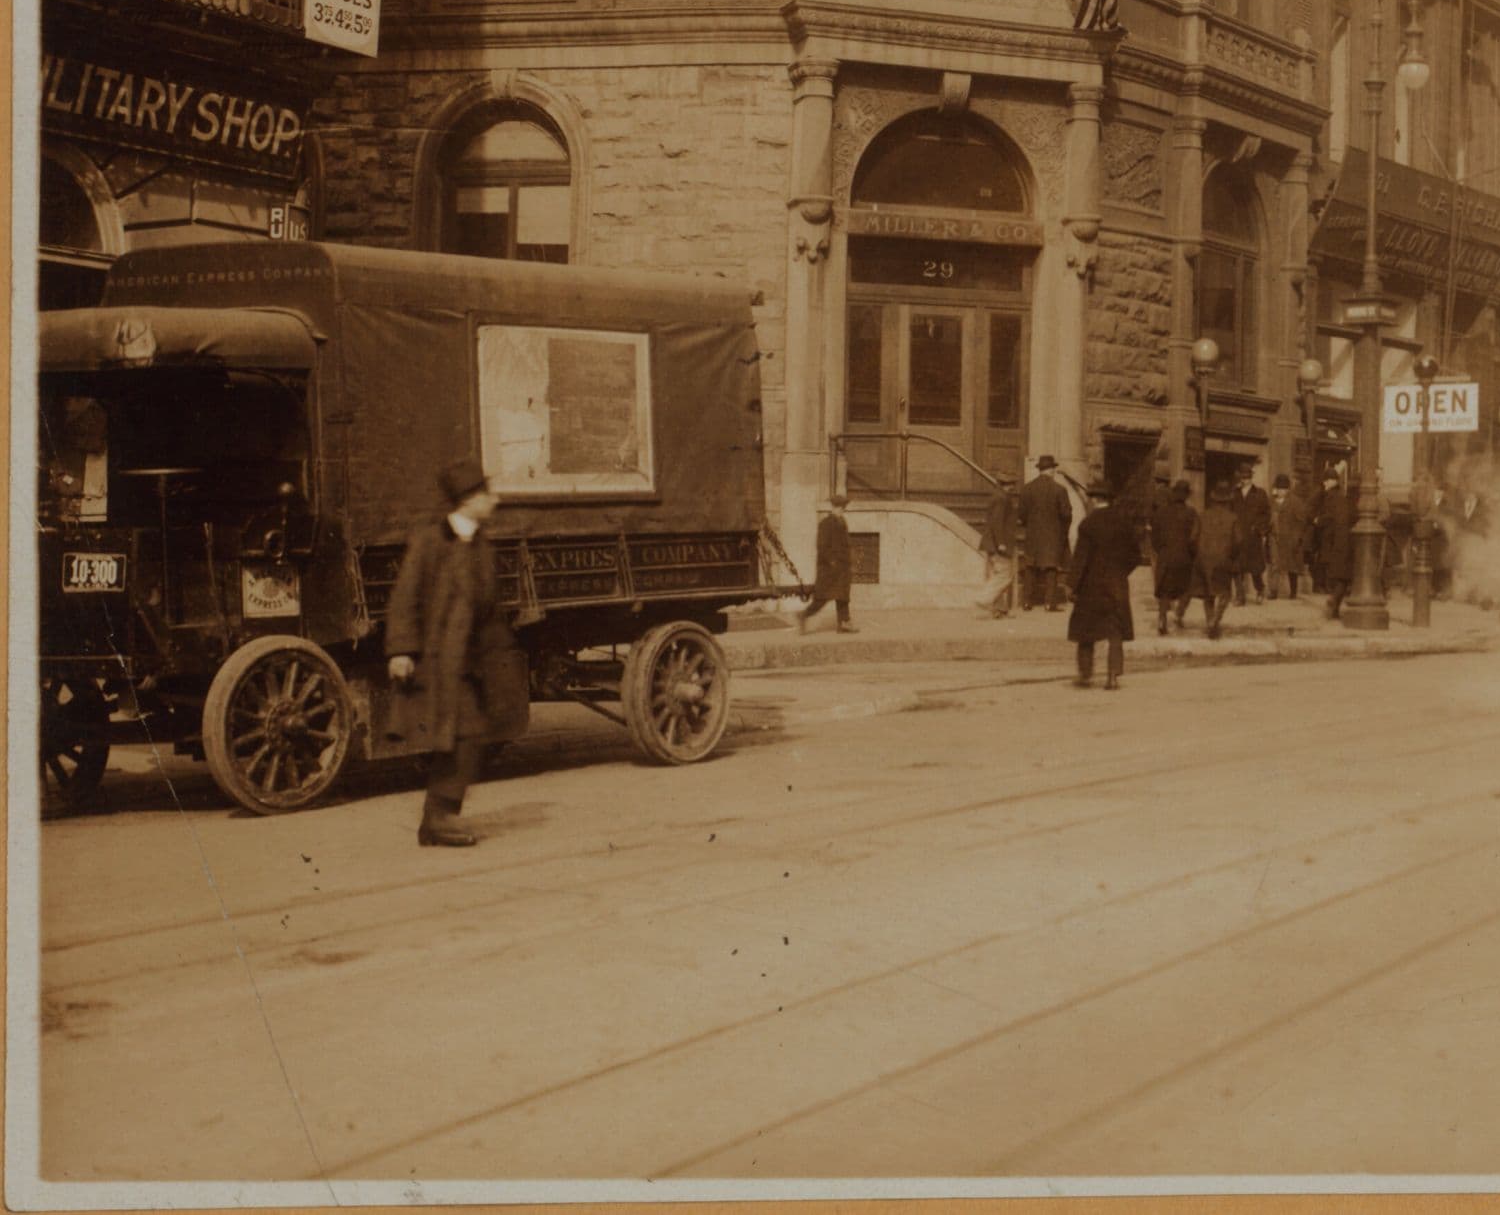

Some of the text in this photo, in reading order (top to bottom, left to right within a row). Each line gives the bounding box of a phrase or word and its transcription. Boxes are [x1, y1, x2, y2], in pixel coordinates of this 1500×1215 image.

[865, 216, 961, 239] MILLER
[970, 223, 984, 238] &
[922, 261, 954, 279] 29
[1395, 390, 1466, 414] OPEN
[642, 542, 732, 564] COMPANY
